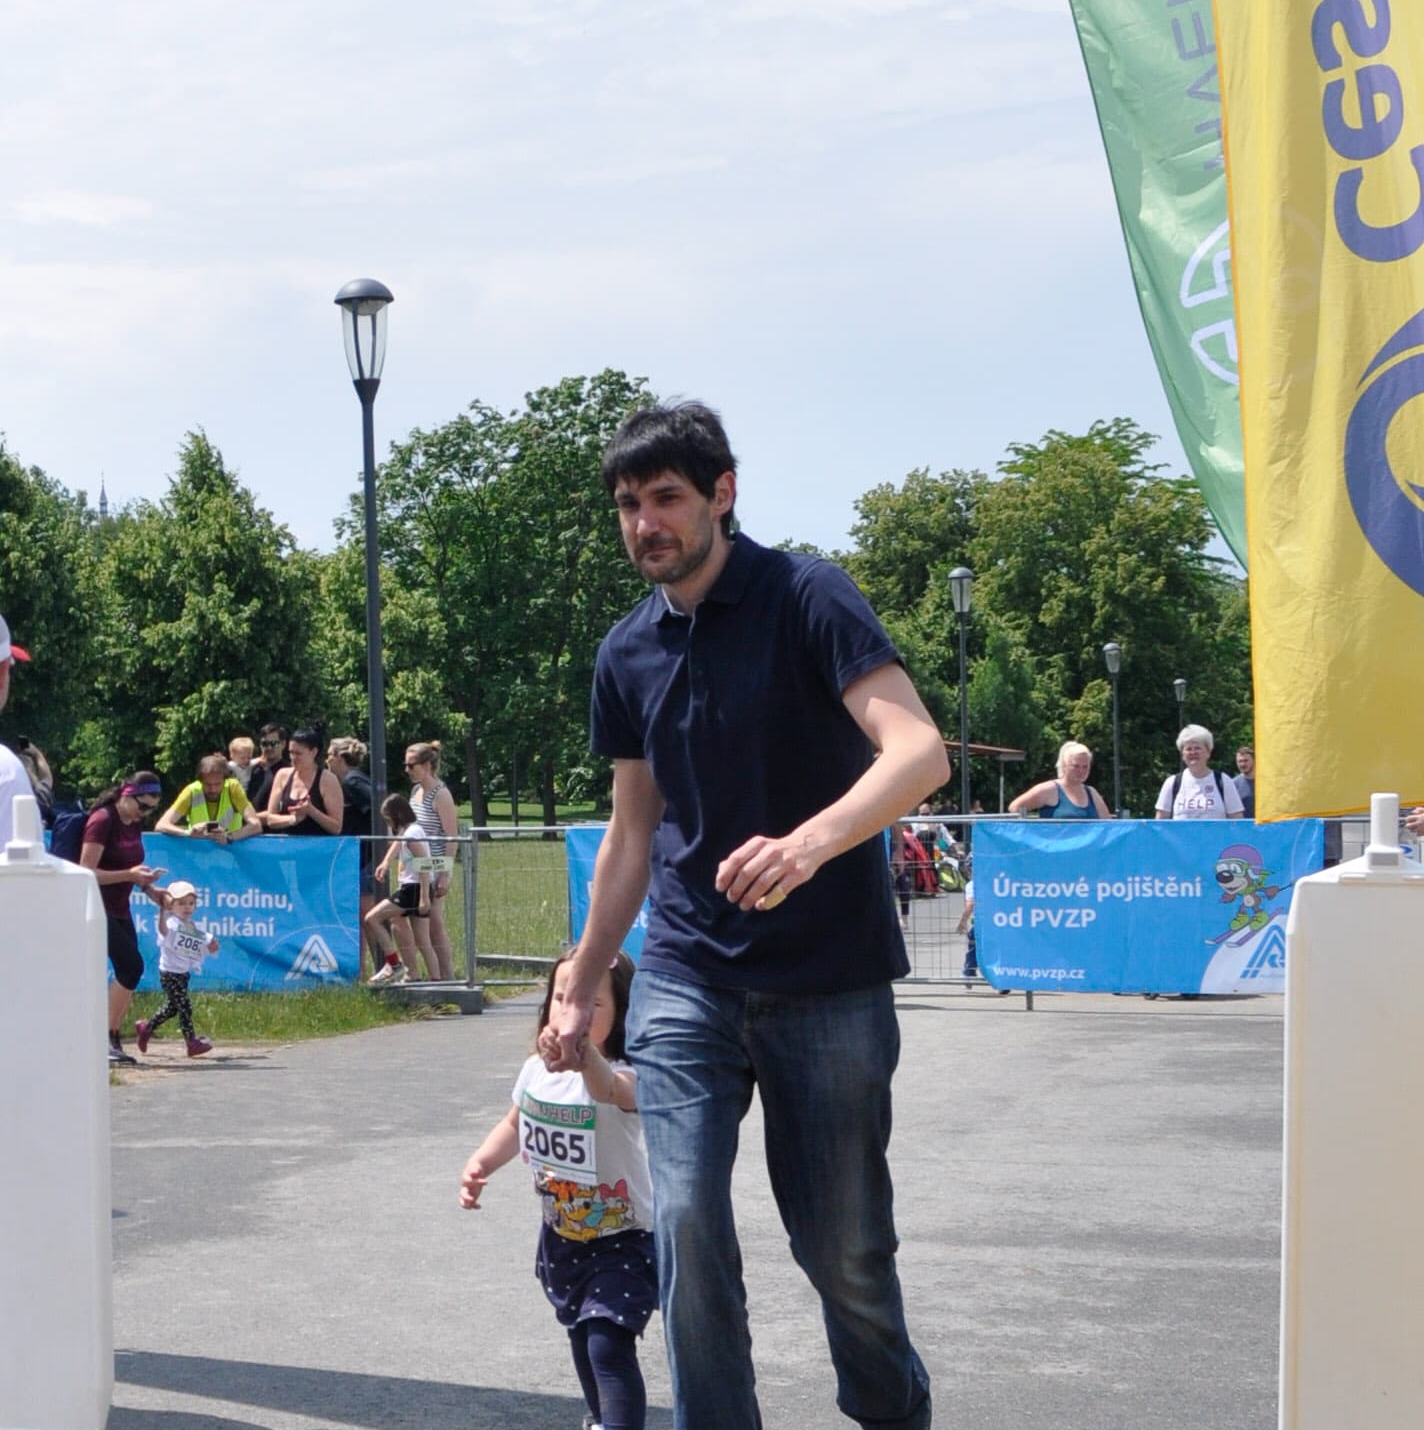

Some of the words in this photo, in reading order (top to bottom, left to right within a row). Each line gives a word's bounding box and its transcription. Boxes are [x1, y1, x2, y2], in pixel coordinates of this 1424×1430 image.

[1178, 798, 1214, 810] HELP
[992, 872, 1090, 898] Úrazové
[1097, 876, 1202, 902] pojištění
[217, 888, 294, 912] rodinu,
[992, 907, 1023, 928] od
[1030, 908, 1097, 928] PVZP
[992, 965, 1086, 981] www.pvzp.cz
[546, 1105, 592, 1124] HELP
[523, 1119, 586, 1165] 2065
